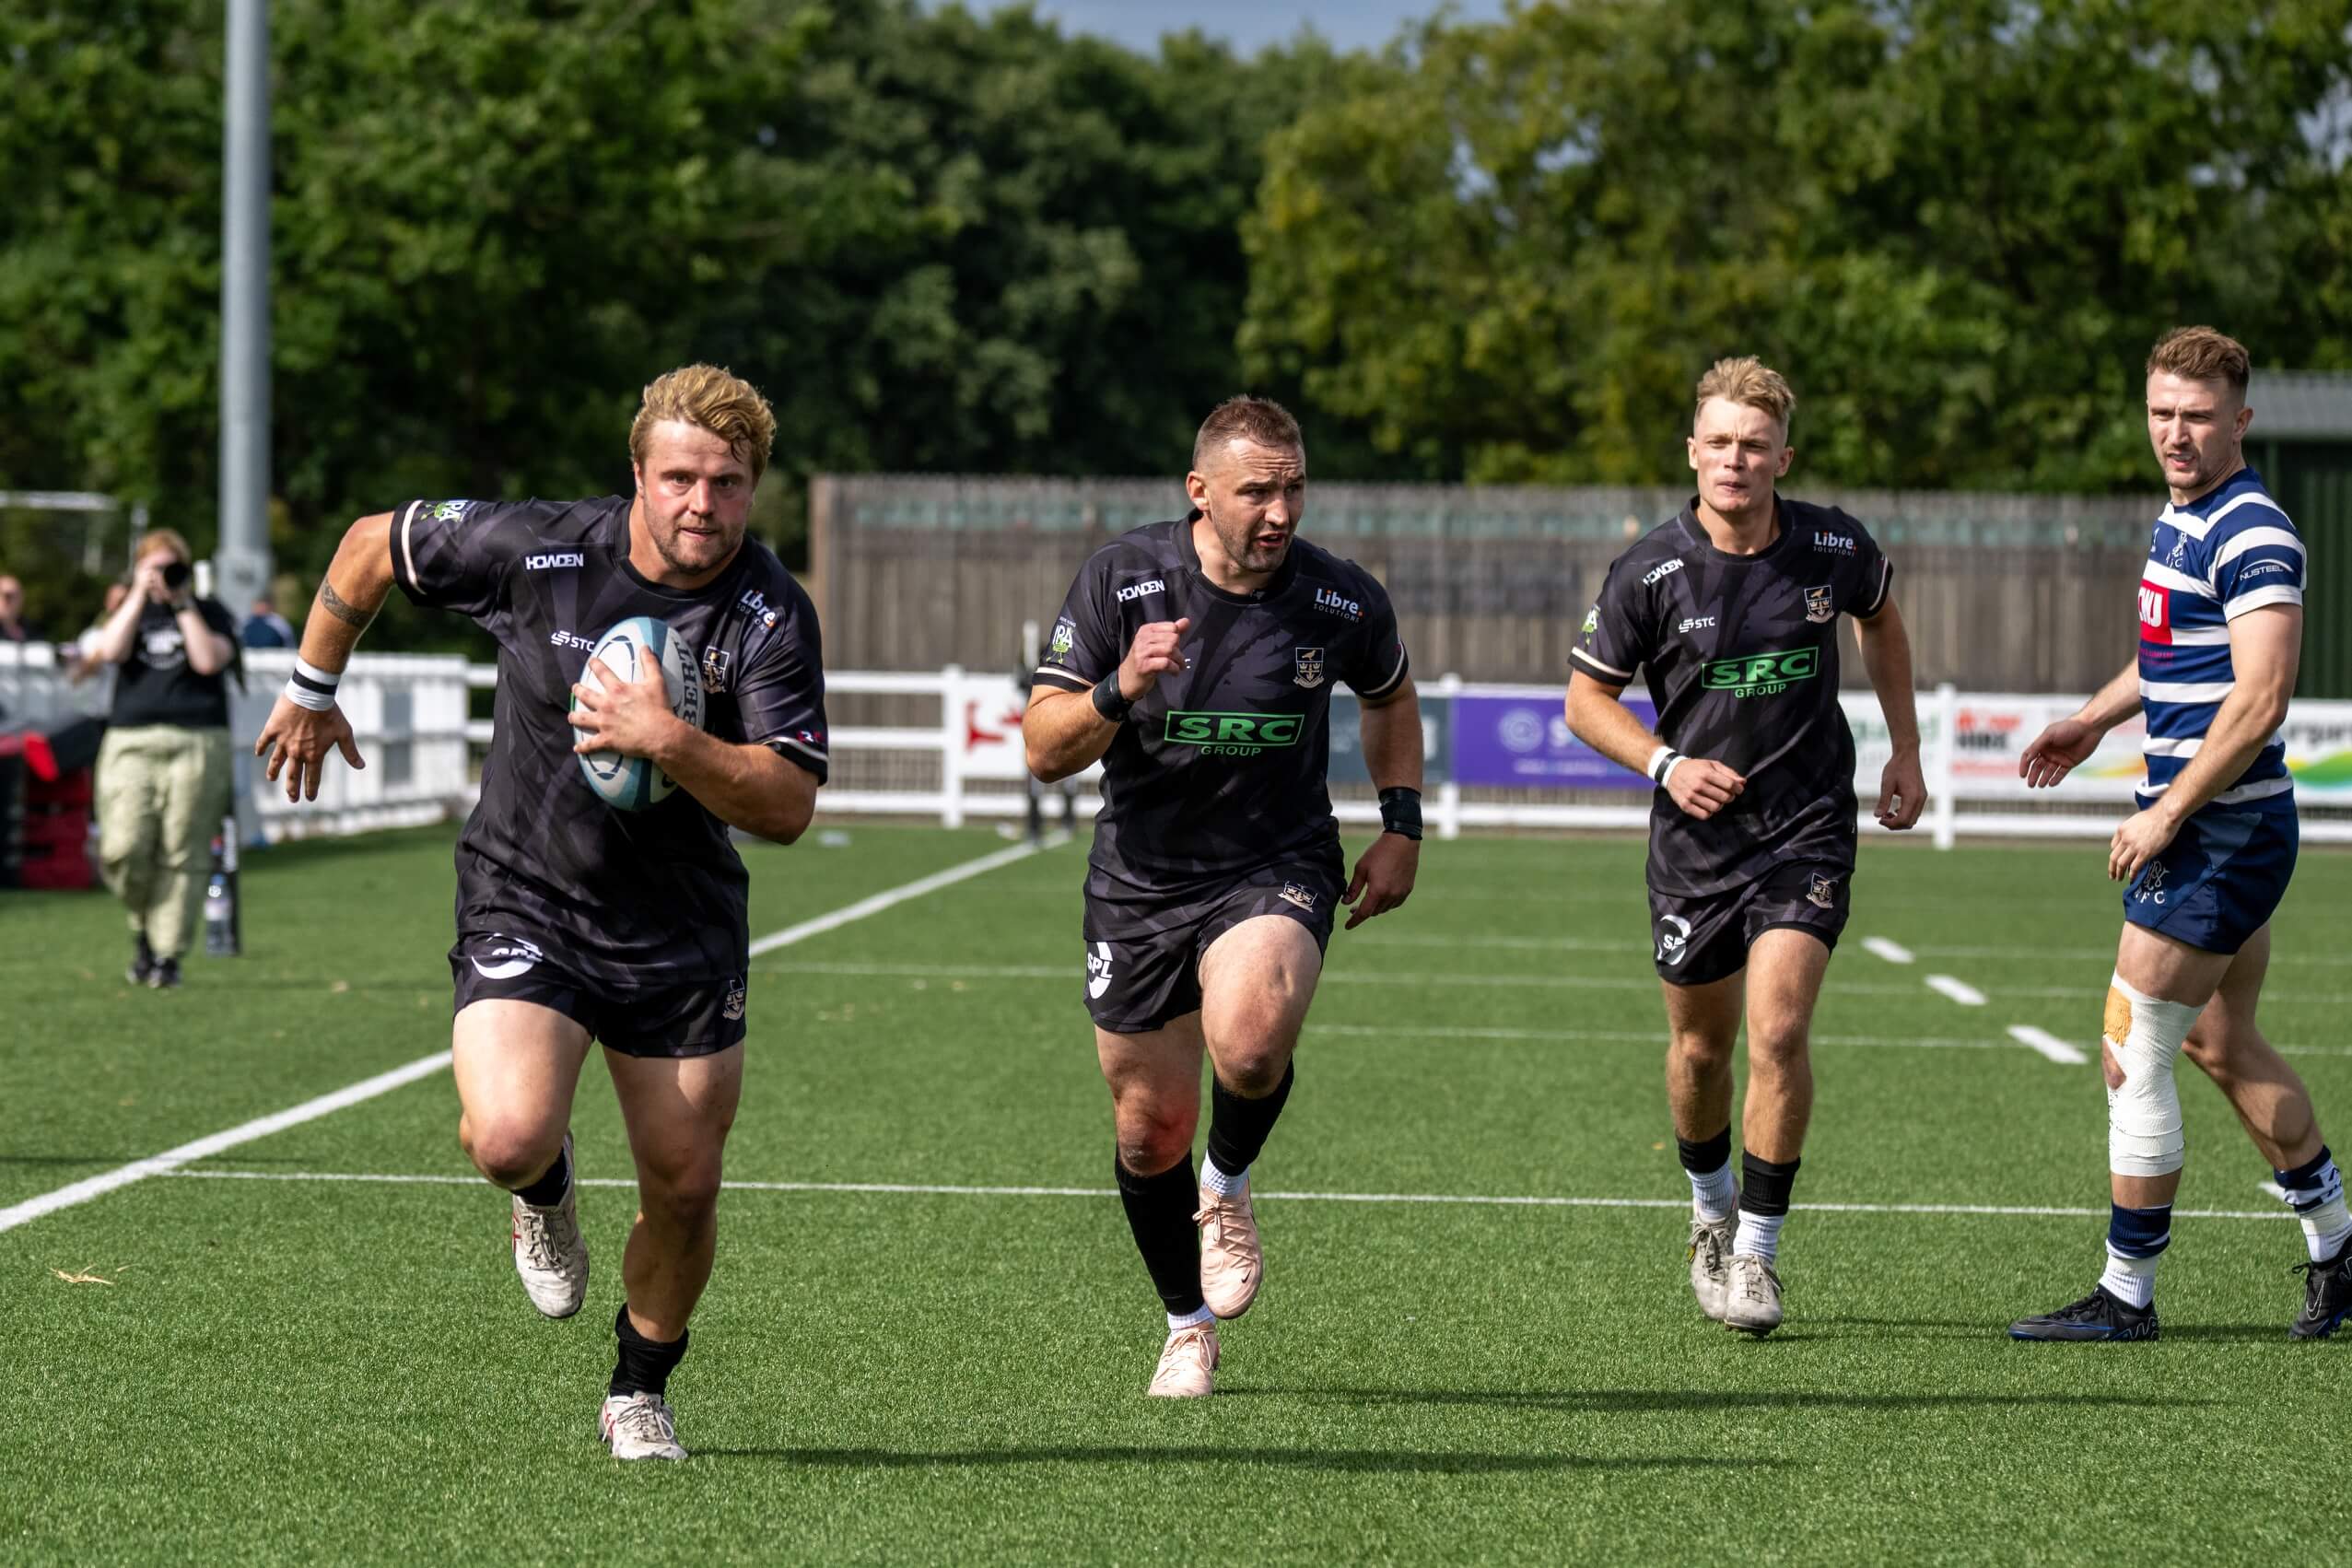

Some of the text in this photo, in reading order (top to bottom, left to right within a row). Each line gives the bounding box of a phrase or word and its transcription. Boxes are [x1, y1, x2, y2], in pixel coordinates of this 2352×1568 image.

[525, 553, 584, 570] HOWDEN
[1643, 557, 1685, 587] HOWDEN
[2240, 564, 2284, 581] NUSTEEL
[1117, 579, 1165, 603] HOWDEN
[1314, 603, 1360, 624] SOLUTIONS
[1694, 616, 1715, 630] STC
[569, 637, 595, 653] STC
[1052, 625, 1073, 649] IPA
[1711, 652, 1810, 685] SRC
[674, 639, 698, 728] BERT
[1735, 683, 1787, 698] GROUP
[1176, 717, 1296, 742] SRC
[1201, 745, 1261, 756] GROUP
[1087, 952, 1114, 979] SPL
